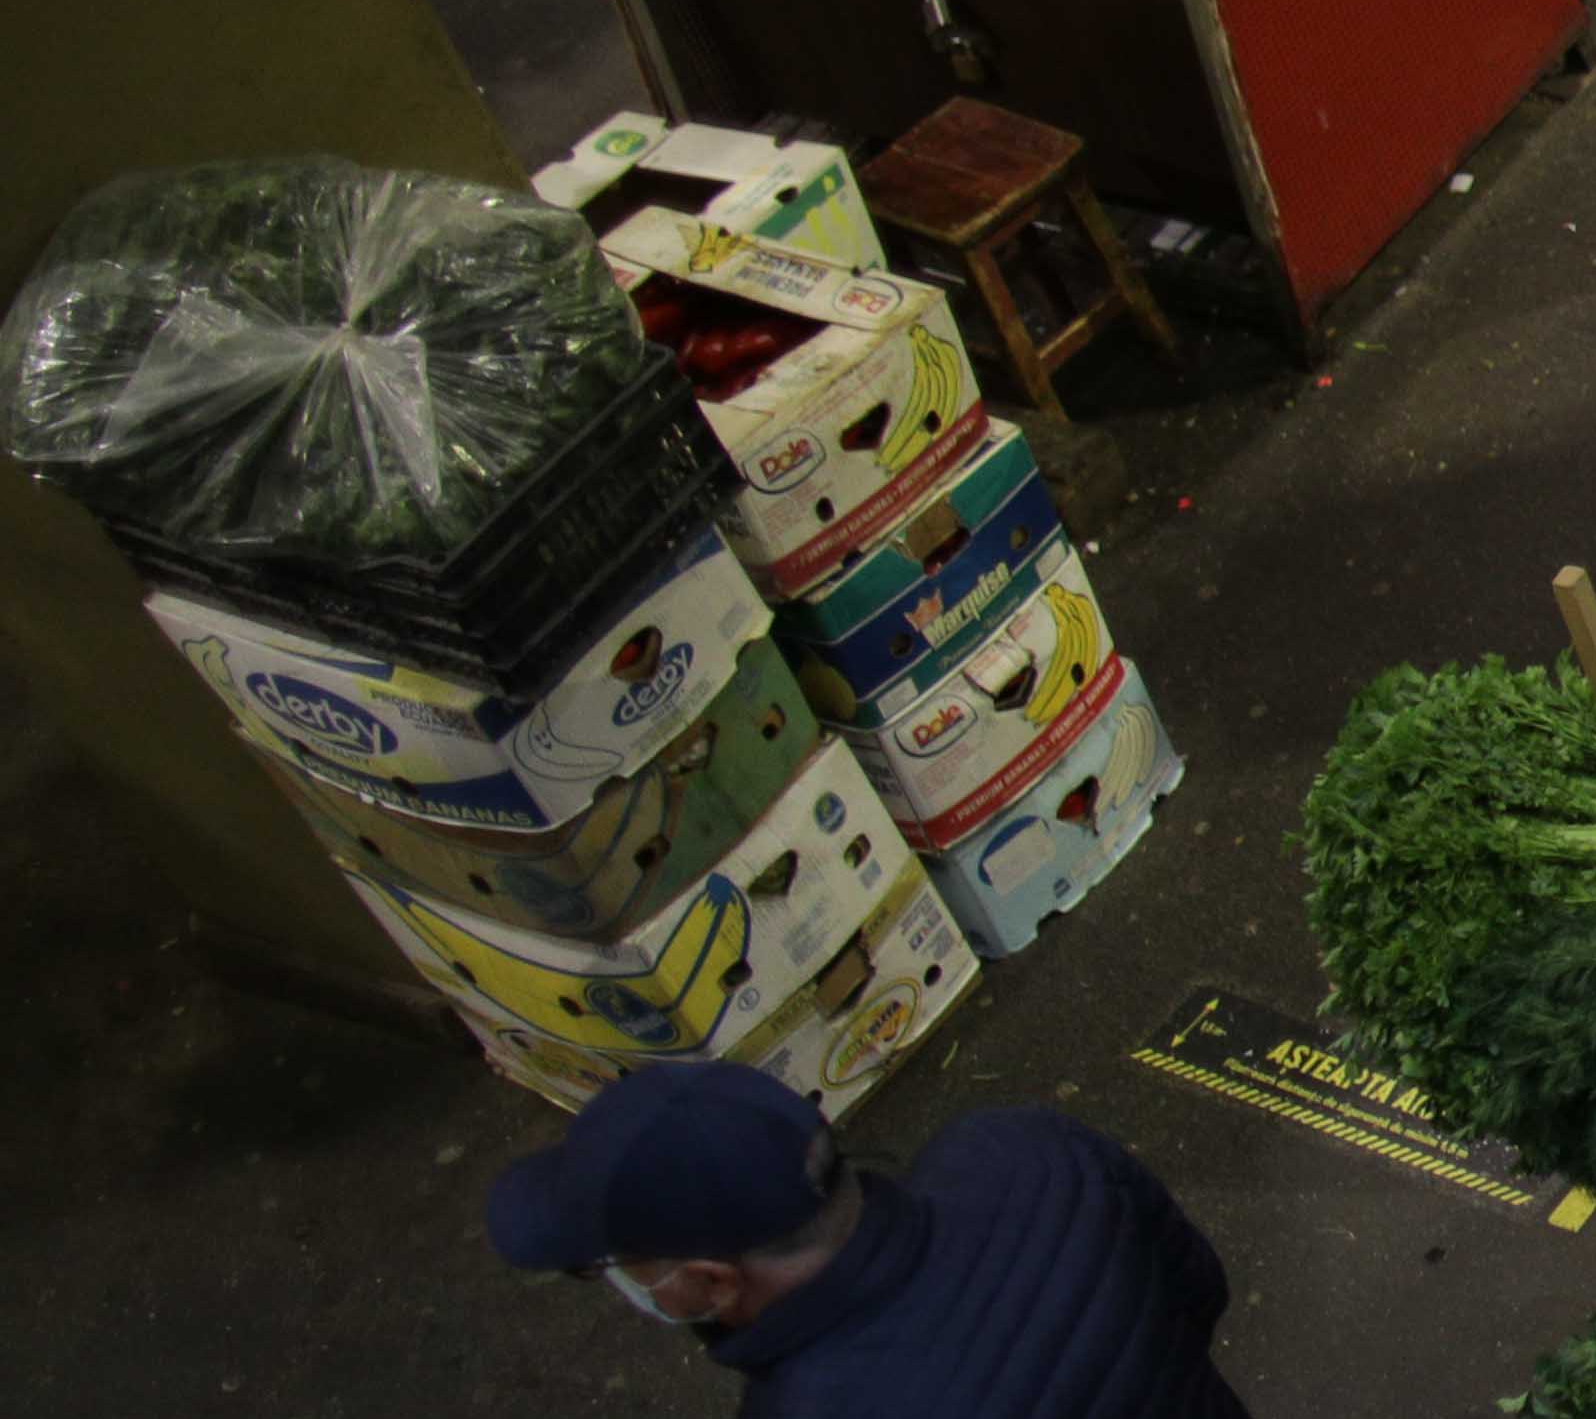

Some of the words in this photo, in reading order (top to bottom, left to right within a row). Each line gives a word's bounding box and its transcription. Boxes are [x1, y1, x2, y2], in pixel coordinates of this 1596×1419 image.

[759, 438, 811, 482] Dole
[618, 643, 692, 723] derby
[256, 671, 384, 753] derby
[912, 702, 965, 749] Dole
[407, 793, 533, 826] BANANAS
